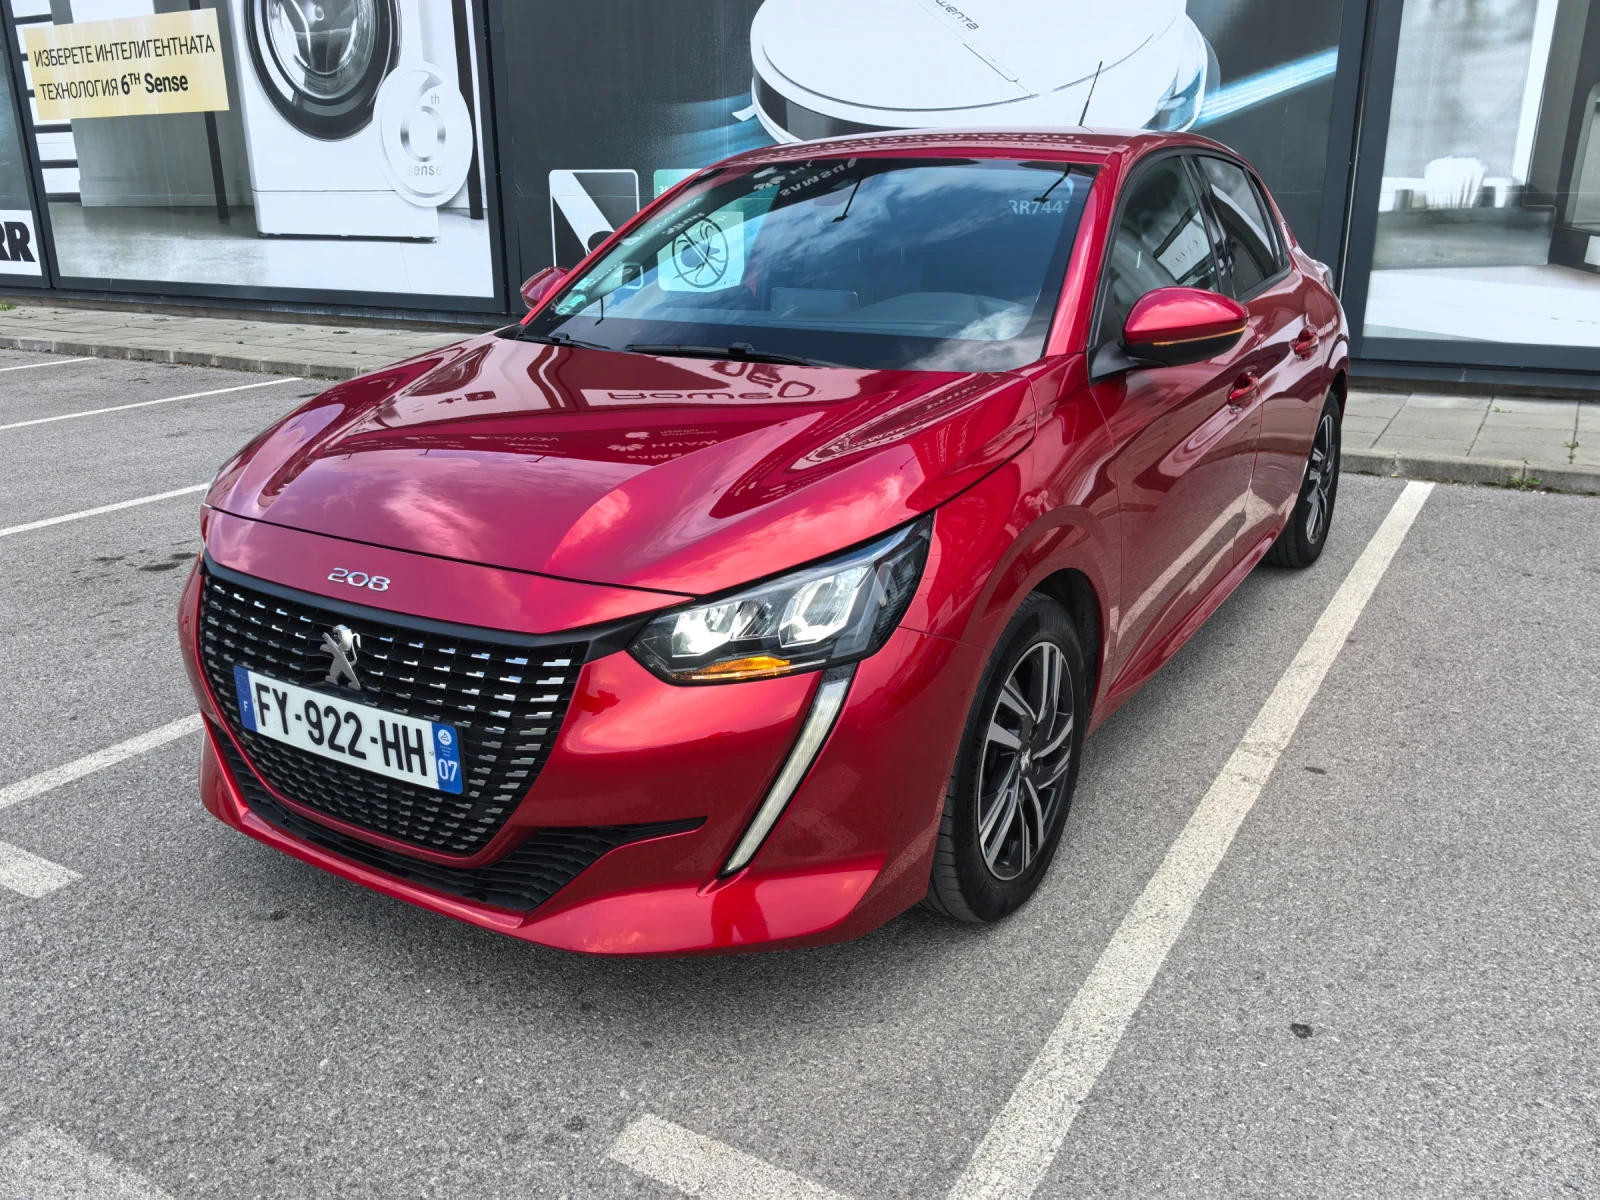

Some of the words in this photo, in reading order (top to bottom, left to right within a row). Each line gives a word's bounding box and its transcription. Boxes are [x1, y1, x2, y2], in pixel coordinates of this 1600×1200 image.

[34, 45, 94, 68] ИЗБЕРЕТЕ
[94, 34, 216, 63] ИНТЕЛИГЕНТНАТА
[39, 78, 119, 101] ТЕХНОЛОГИЯ
[144, 73, 189, 95] Sense
[406, 164, 443, 177] sense
[328, 567, 391, 592] 208
[243, 700, 249, 713] F
[255, 681, 428, 777] FY-922-HH
[438, 758, 458, 782] 07
